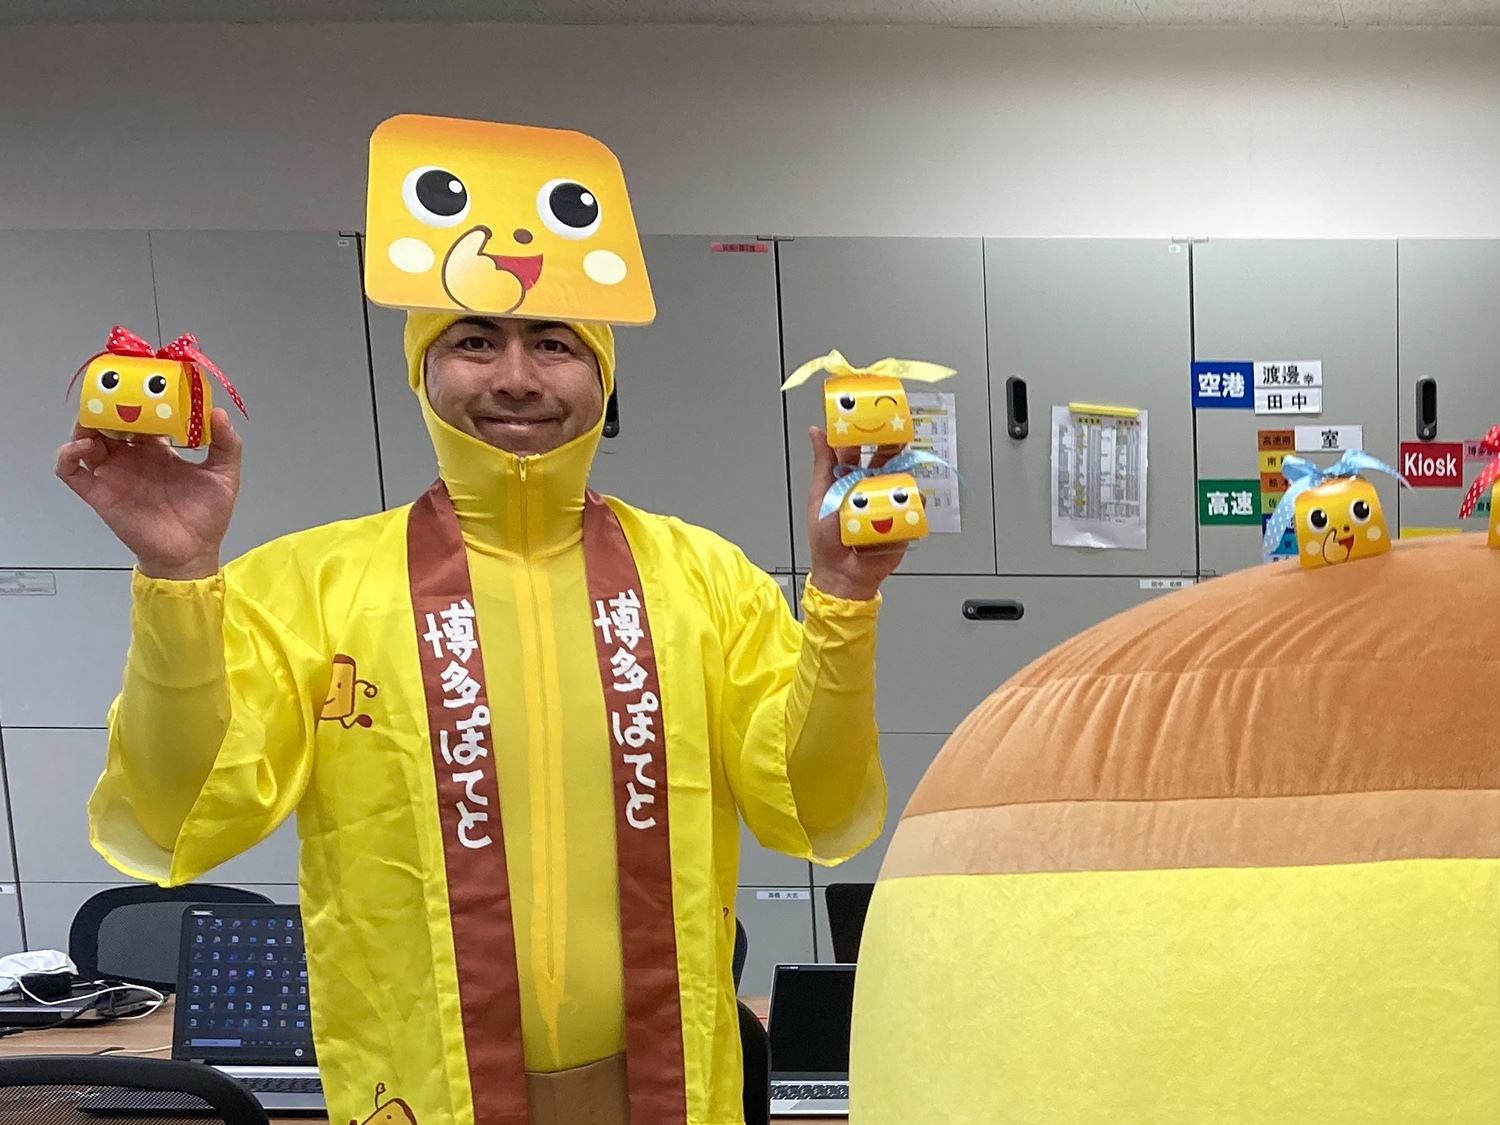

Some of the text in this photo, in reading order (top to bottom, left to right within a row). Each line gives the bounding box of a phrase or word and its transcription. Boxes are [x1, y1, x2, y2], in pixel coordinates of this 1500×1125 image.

[1198, 372, 1245, 398] 空港
[1267, 391, 1307, 410] 田中
[1404, 452, 1458, 477] Kiosk
[1206, 490, 1253, 516] 高速
[593, 588, 660, 830] 博多ぽてと
[422, 598, 493, 849] 博多ぽてと
